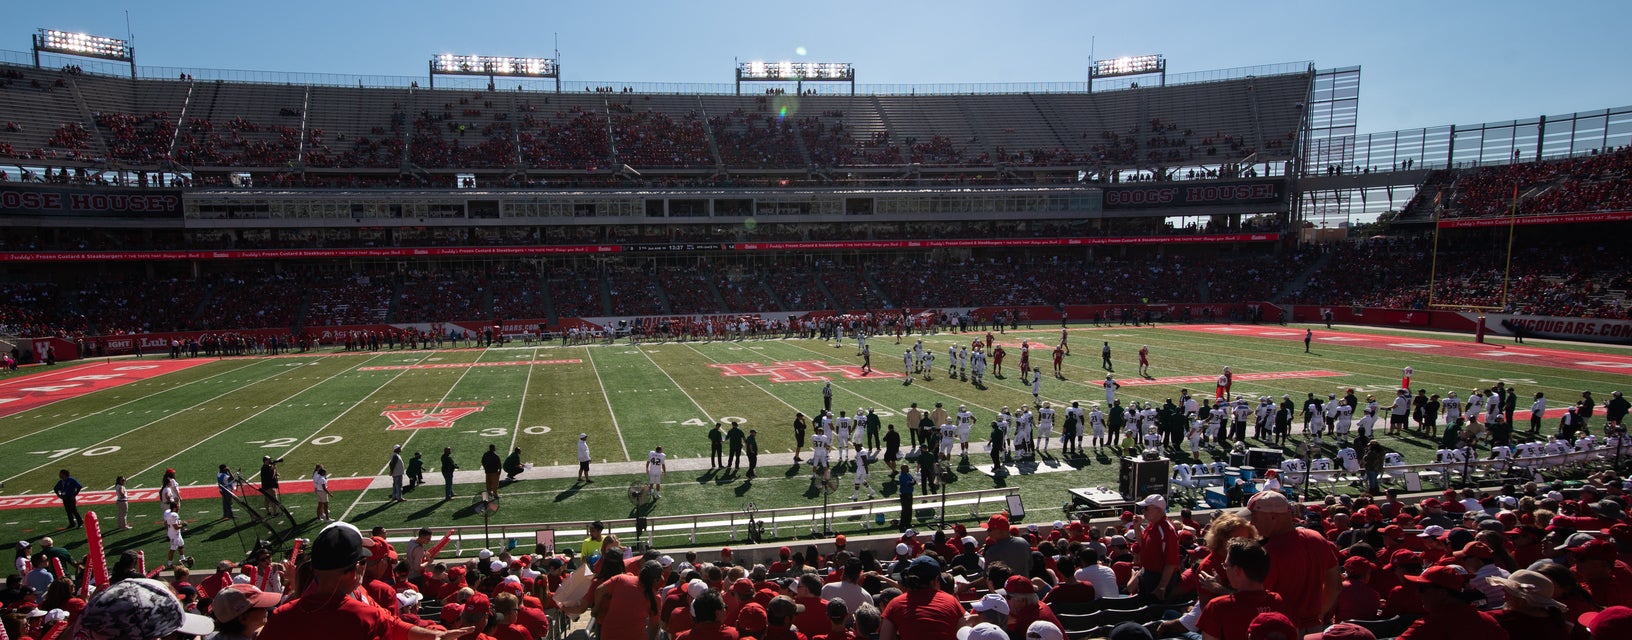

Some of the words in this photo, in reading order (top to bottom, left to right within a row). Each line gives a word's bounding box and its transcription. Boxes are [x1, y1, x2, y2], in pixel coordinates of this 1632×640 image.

[0, 191, 62, 209] OSE
[70, 193, 178, 211] HOUSE?
[1106, 189, 1178, 205] COOGS'
[1186, 184, 1274, 202] HOUSE!
[681, 416, 748, 427] 40
[479, 426, 550, 437] 30
[260, 435, 344, 449] 20
[48, 445, 121, 460] 10
[650, 458, 661, 466] 42
